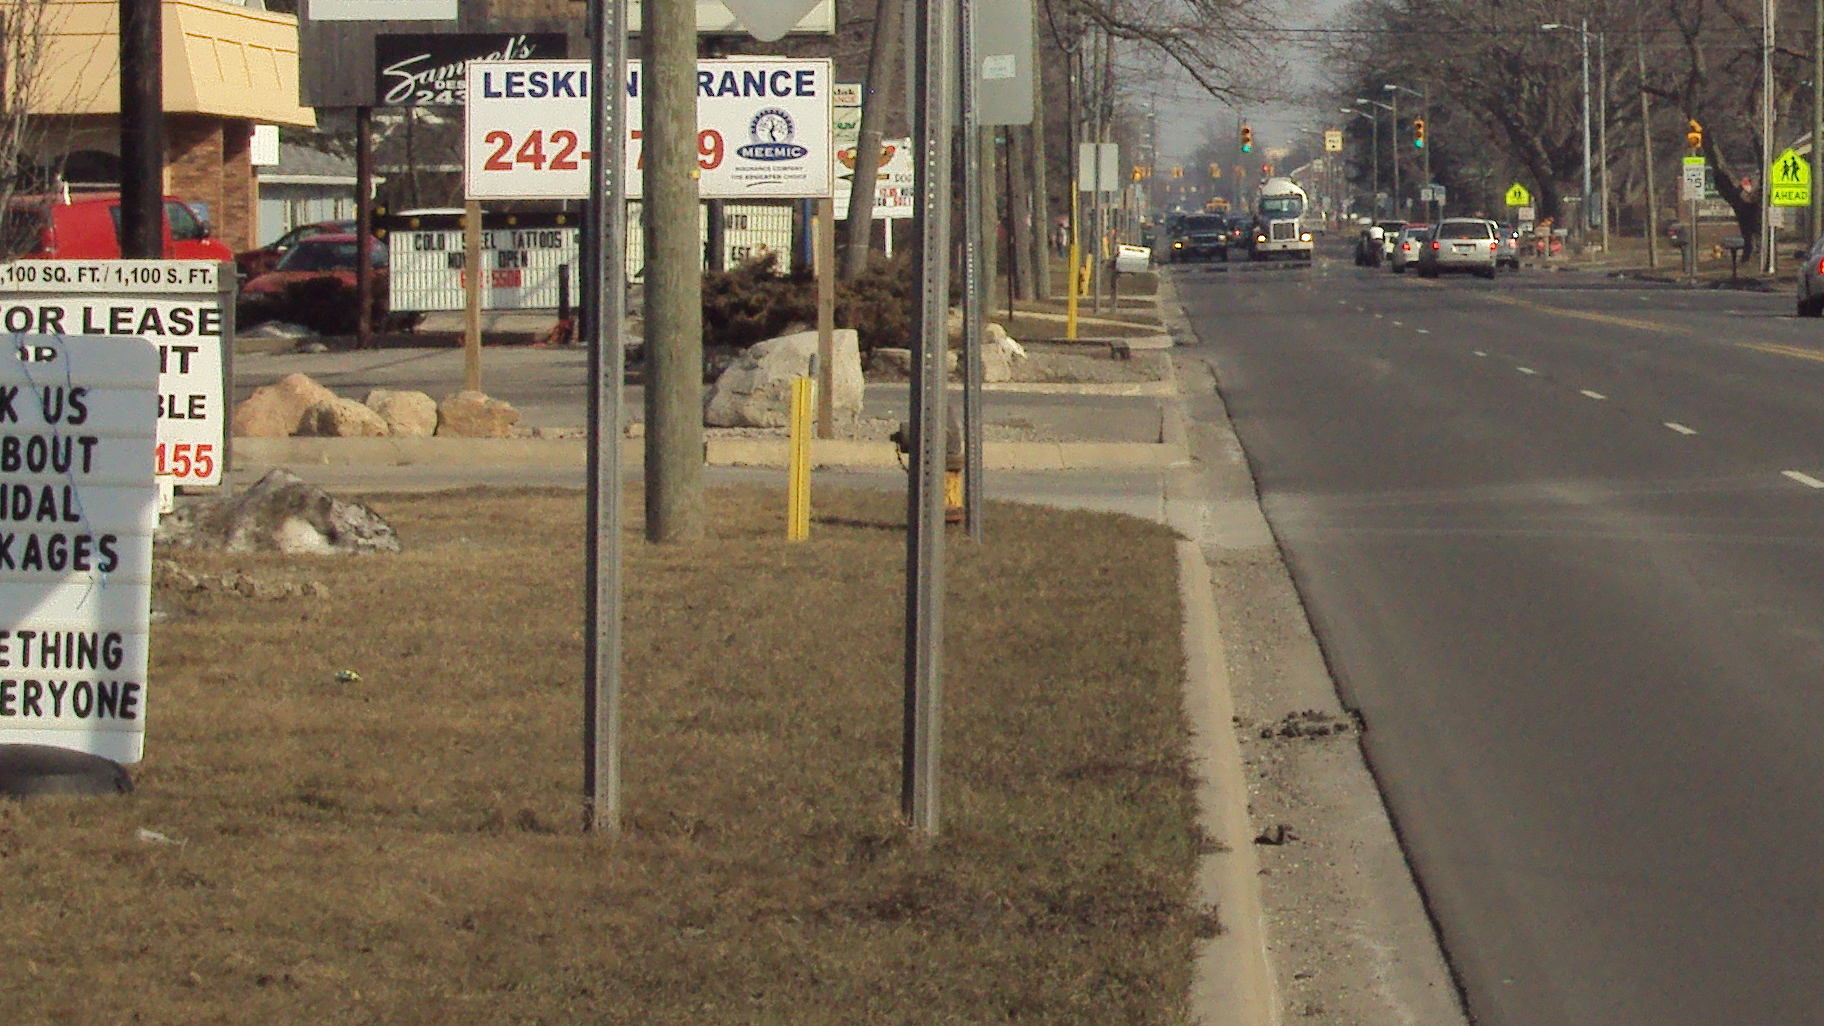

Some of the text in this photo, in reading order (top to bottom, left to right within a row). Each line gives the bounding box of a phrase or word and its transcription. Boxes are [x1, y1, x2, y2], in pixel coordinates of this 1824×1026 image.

[383, 34, 536, 104] Samel's
[484, 70, 588, 98] LESKI
[741, 146, 803, 158] MEEMIC
[1774, 191, 1808, 201] AHEAD
[414, 233, 445, 251] COLD
[511, 231, 562, 249] TATTOOS
[448, 251, 529, 269] NO OPEN
[42, 266, 72, 283] SQ.
[115, 267, 161, 286] 1,100
[167, 268, 183, 284] S.
[189, 268, 213, 285] FT.
[3, 306, 223, 336] OR LEASE
[43, 386, 89, 425] US
[1, 434, 99, 473] BOUT
[0, 679, 141, 720] ERYONE
